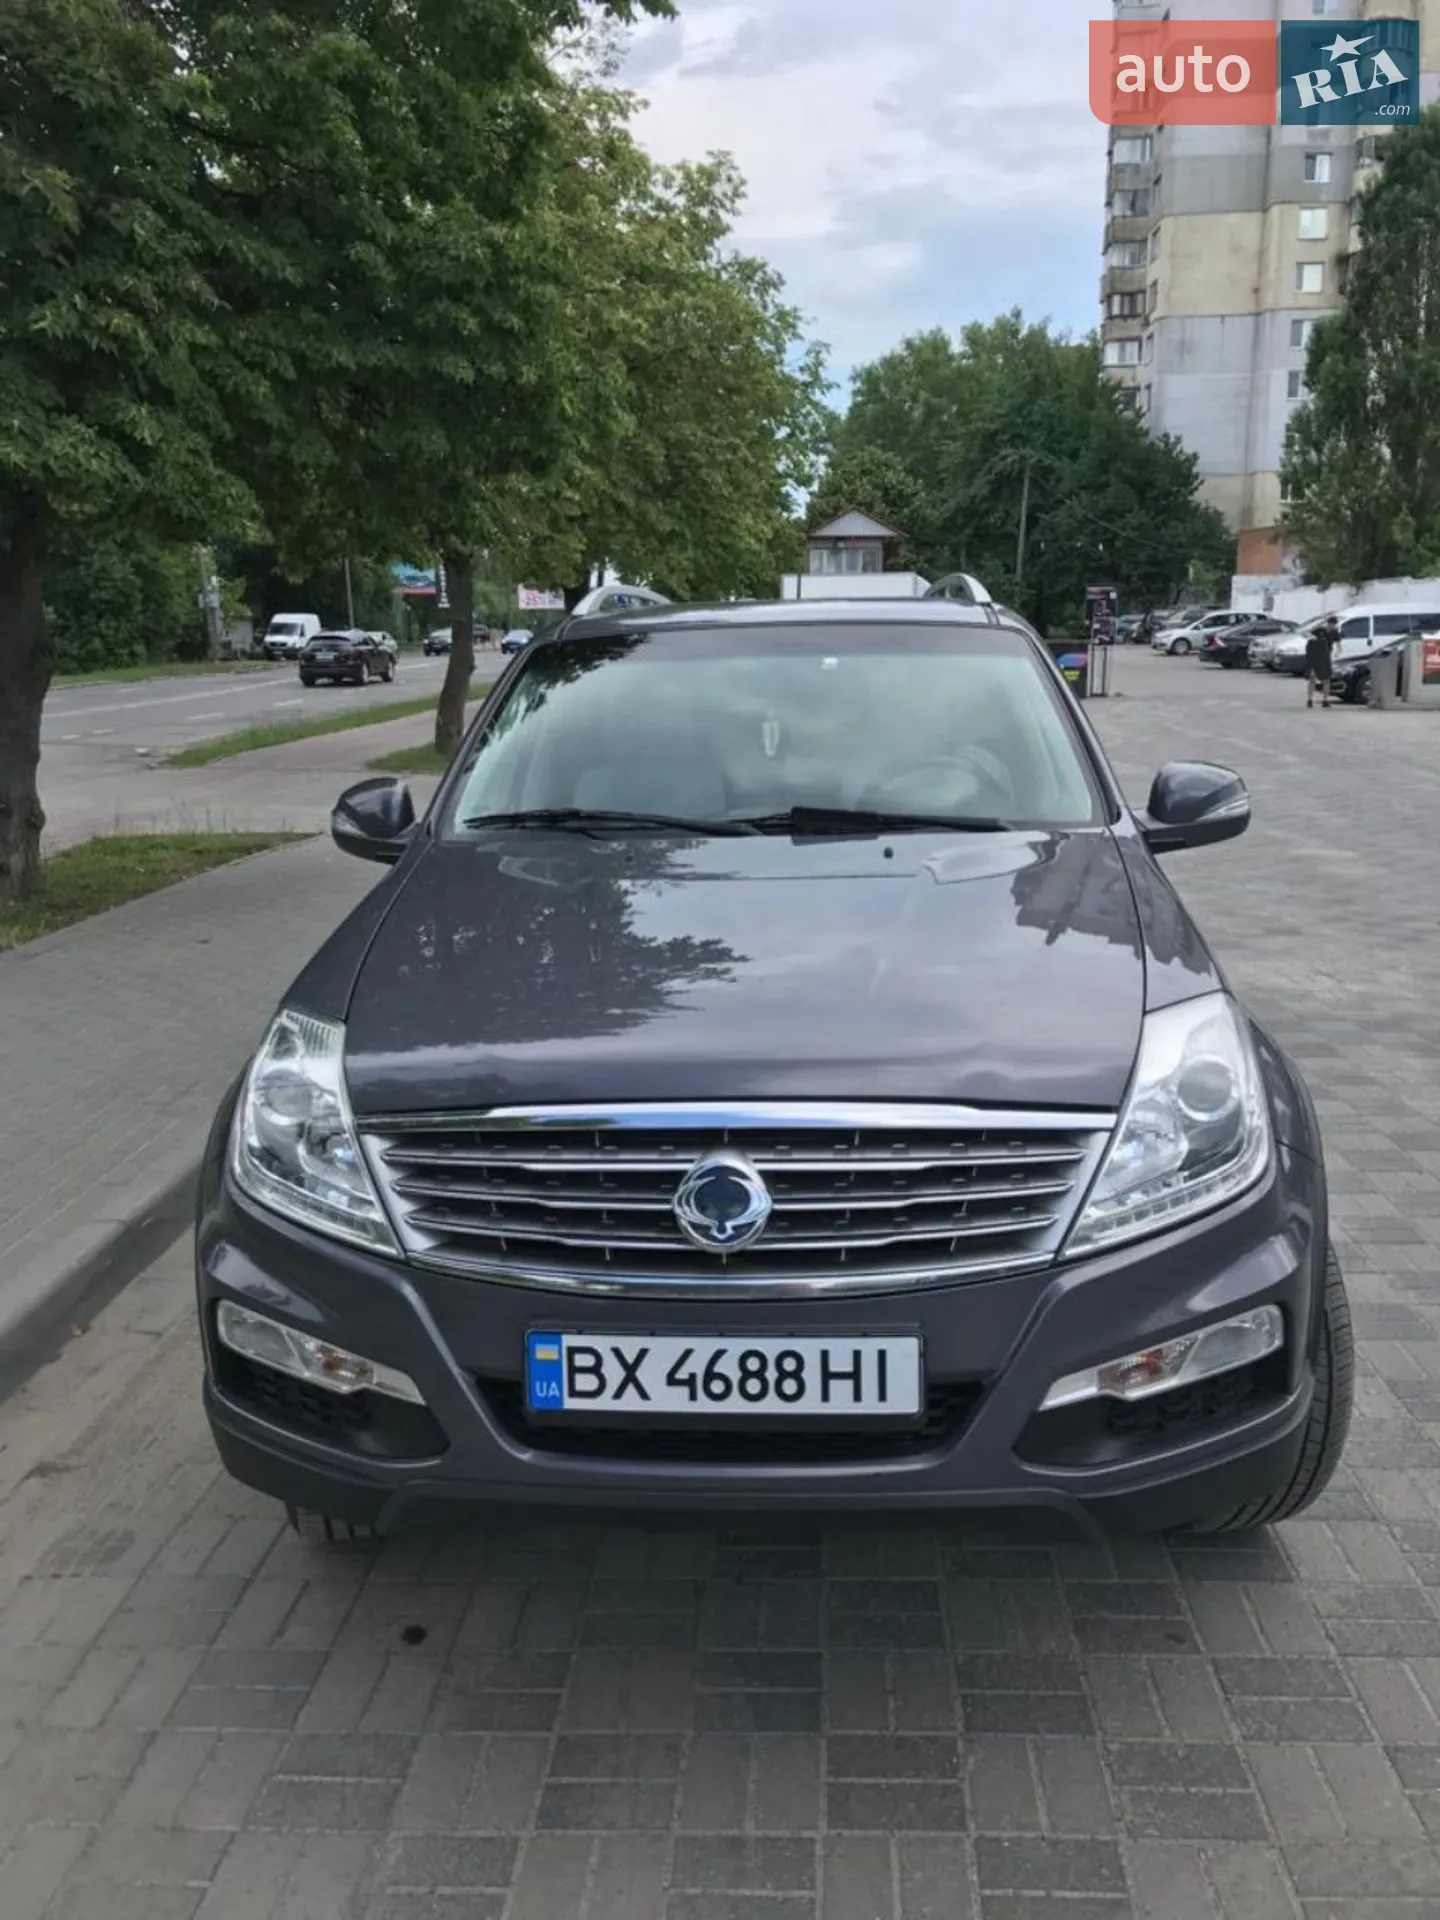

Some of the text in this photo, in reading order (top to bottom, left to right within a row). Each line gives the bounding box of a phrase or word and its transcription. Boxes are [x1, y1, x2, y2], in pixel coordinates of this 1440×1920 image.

[536, 1381, 560, 1398] UA
[566, 1345, 888, 1404] BX 4688 HI
